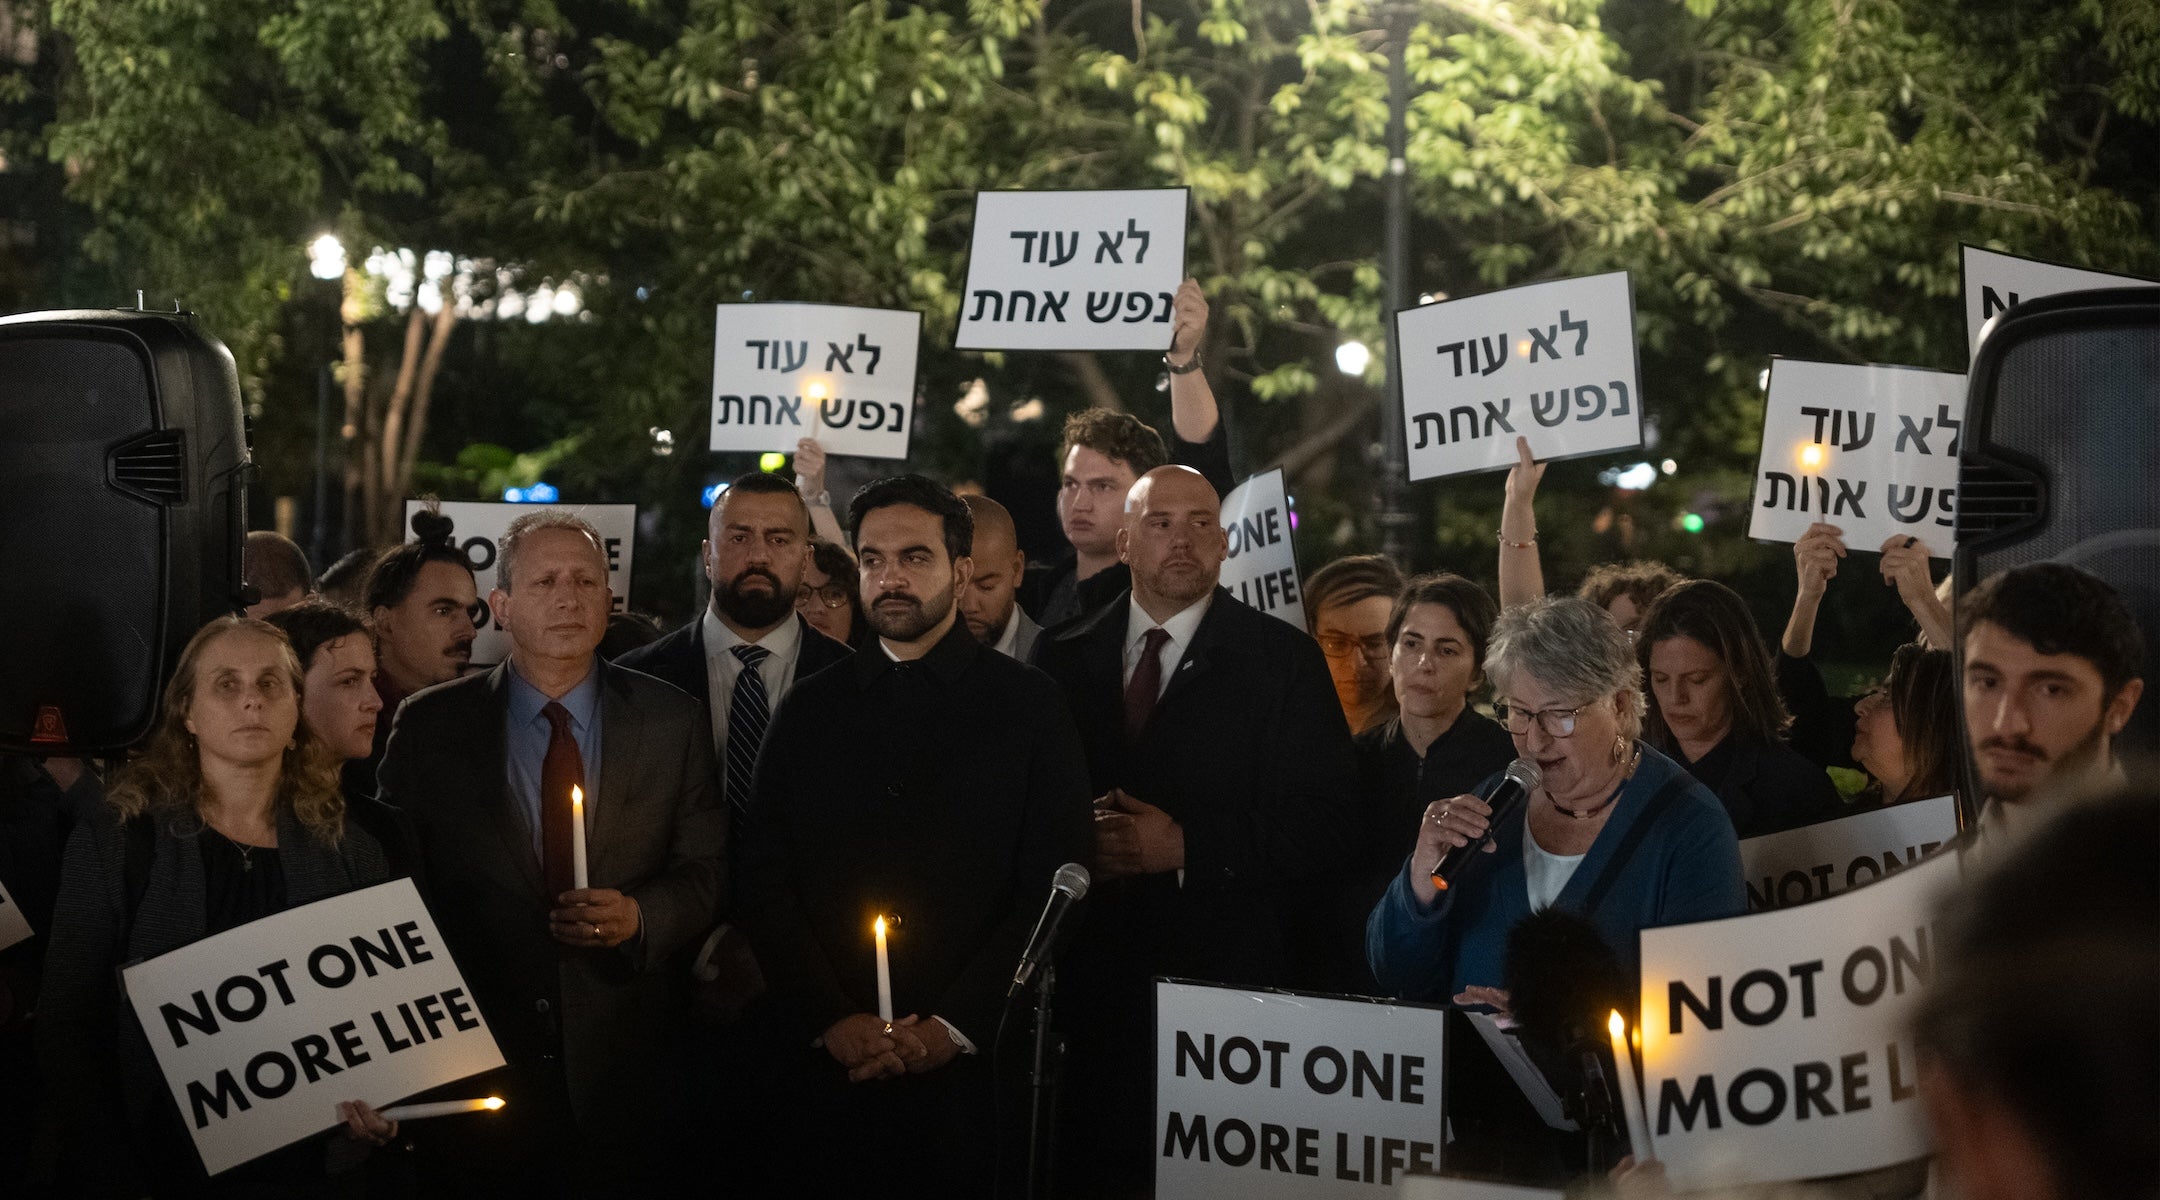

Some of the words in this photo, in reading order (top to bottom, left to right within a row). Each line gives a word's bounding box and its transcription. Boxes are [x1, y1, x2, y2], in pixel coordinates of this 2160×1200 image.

[1010, 230, 1079, 267] עוד
[1095, 218, 1150, 264] לא
[968, 290, 1070, 322] אחת
[1086, 290, 1173, 323] נפש
[745, 340, 808, 373] עוד
[825, 333, 881, 375] לא
[1437, 333, 1508, 377] עוד
[1527, 309, 1588, 363] לא
[717, 395, 801, 426] אחת
[820, 397, 904, 432] נפש
[1412, 398, 1516, 449] אחת
[1530, 380, 1630, 428] נפש
[1801, 406, 1876, 452] עוד
[1895, 404, 1962, 457] לא
[1763, 471, 1867, 518] אחת
[1227, 507, 1281, 558] ONE
[1746, 864, 1833, 910] NOT
[159, 959, 297, 1048] NOT
[307, 921, 433, 988] ONE
[1668, 959, 1823, 1034] NOT
[1841, 925, 1935, 1007] ON
[185, 1020, 371, 1128] MORE
[371, 987, 480, 1054] LIFE
[1175, 1030, 1290, 1089] NOT
[1303, 1045, 1425, 1105] ONE
[1657, 1051, 1871, 1136] MORE
[1162, 1111, 1319, 1176] MORE
[1336, 1132, 1434, 1186] LIFE
